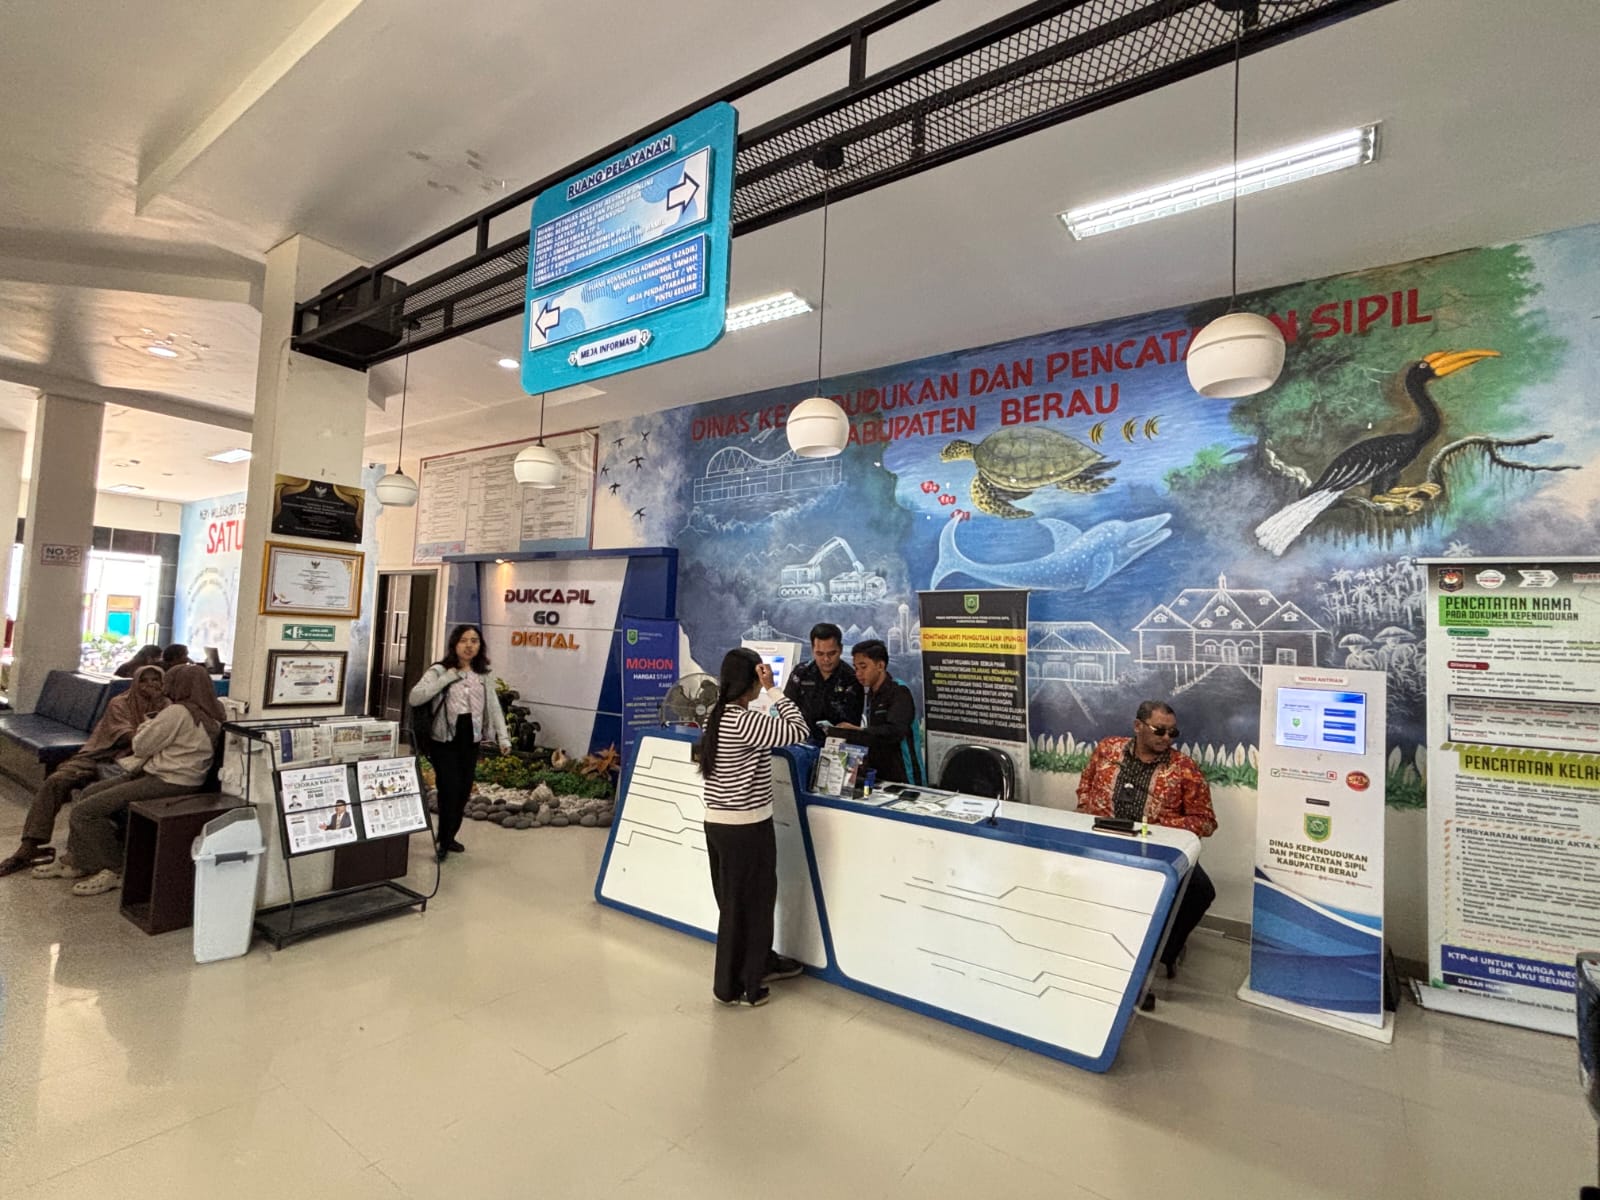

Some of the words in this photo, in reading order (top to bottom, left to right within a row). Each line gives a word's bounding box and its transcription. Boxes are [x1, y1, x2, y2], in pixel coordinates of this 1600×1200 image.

[568, 171, 604, 199] RUANG
[606, 136, 671, 179] PELAYANAN
[581, 348, 597, 359] MEJA
[600, 335, 636, 353] INFORMASI
[691, 411, 750, 441] DINAS
[970, 358, 1033, 396] DAN
[1311, 288, 1433, 340] SIPIL
[1000, 382, 1119, 427] BERAU
[504, 589, 596, 605] DUKCAPIL
[1445, 596, 1526, 610] PENCATATAN
[1532, 597, 1571, 610] NAMA
[533, 610, 560, 625] GO
[1445, 610, 1466, 618] PADA
[1469, 610, 1507, 619] DOKUMEN
[1511, 610, 1578, 620] KEPENDUDUKAN
[511, 631, 580, 650] DIGITAL
[626, 658, 673, 670] MOHON
[1465, 754, 1552, 776] PENCATATAN
[1456, 826, 1517, 840] PERSYARATAN
[1520, 834, 1564, 846] MEMBUAT
[1567, 839, 1591, 849] AKTA
[1269, 839, 1293, 849] DINAS
[1296, 842, 1367, 864] KEPENDUDUKAN
[1269, 847, 1285, 856] DAN
[1288, 849, 1341, 867] PENCATATAN
[1344, 860, 1366, 871] SIPIL
[1277, 856, 1325, 873] KABUPATEN
[1328, 866, 1358, 878] BERAU
[1447, 951, 1477, 962] KTP-el
[1480, 957, 1514, 969] UNTUK
[1517, 963, 1554, 976] WARGA
[1488, 966, 1535, 981] BERLAKU
